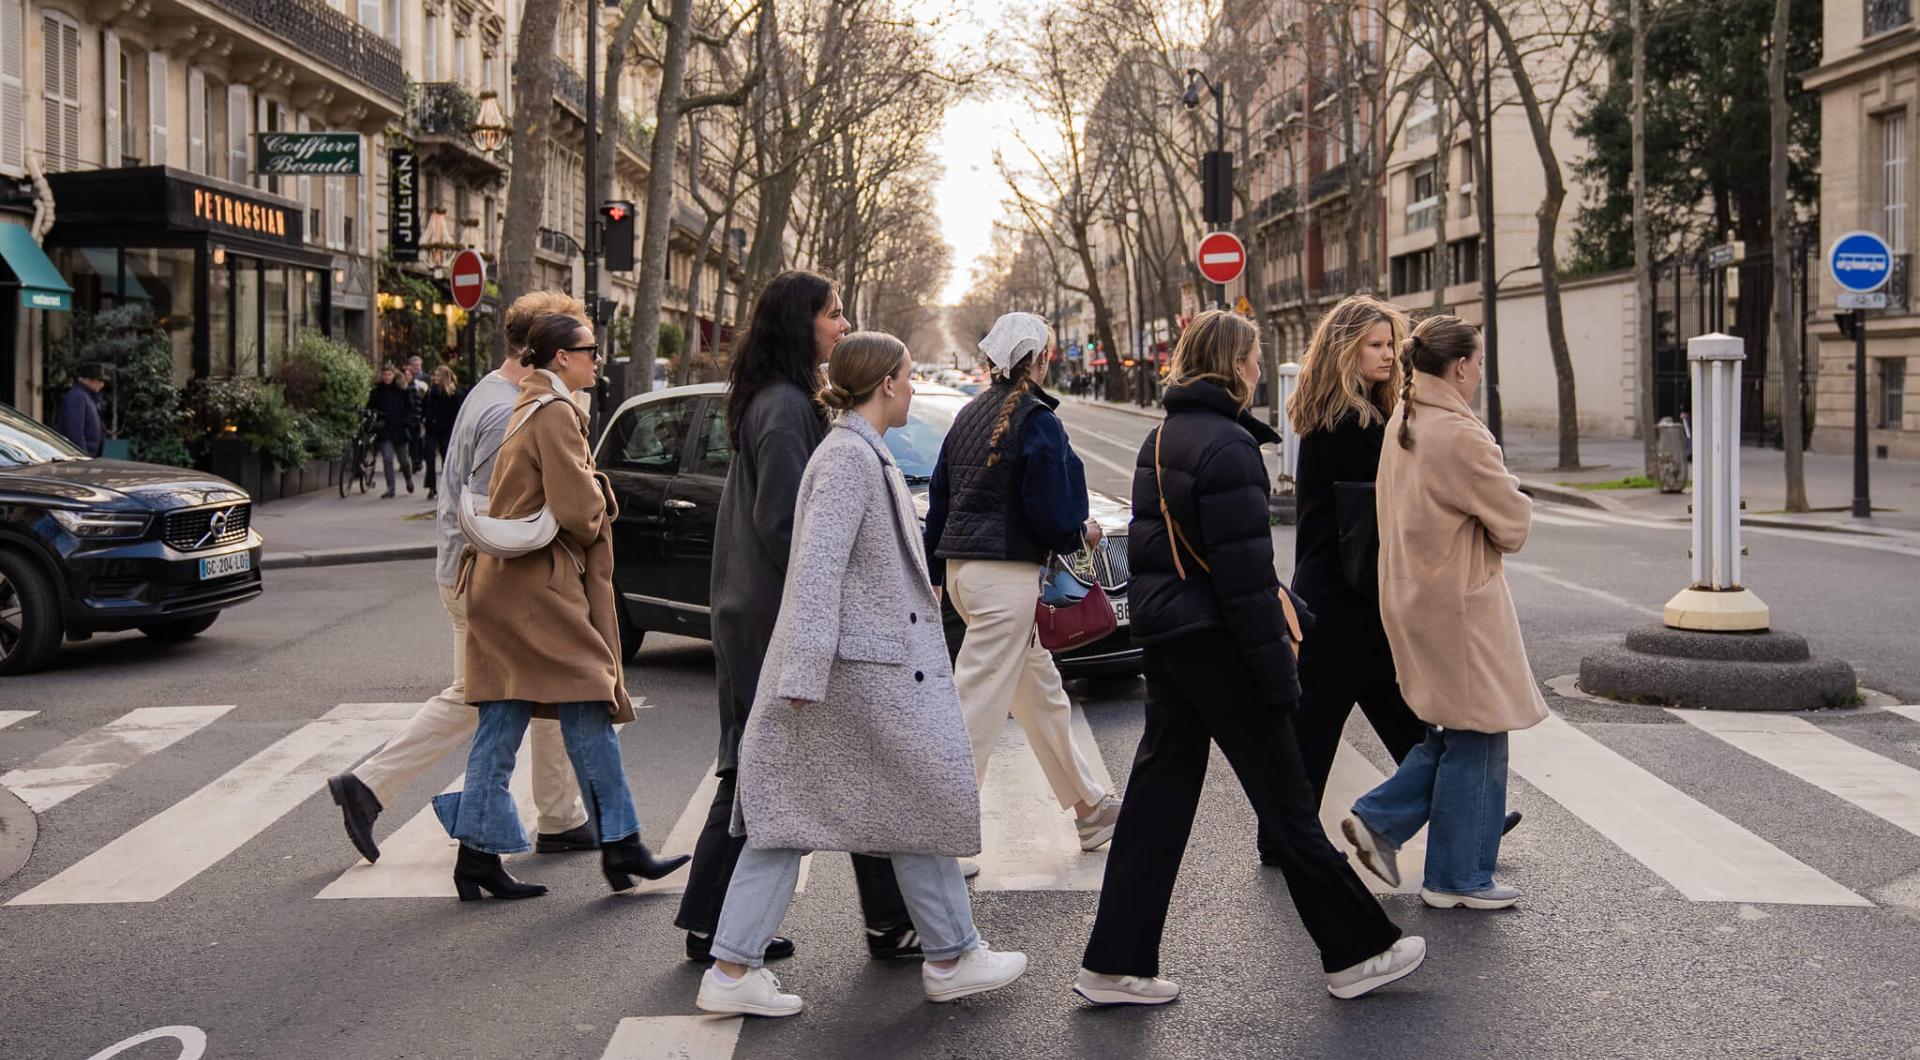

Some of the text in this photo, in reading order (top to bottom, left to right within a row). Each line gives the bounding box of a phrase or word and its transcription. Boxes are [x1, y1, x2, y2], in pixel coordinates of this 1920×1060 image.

[263, 135, 357, 159] Coiffure
[266, 155, 355, 173] Beauté
[194, 189, 285, 236] PETROSSIAN
[398, 154, 413, 242] JULIAN
